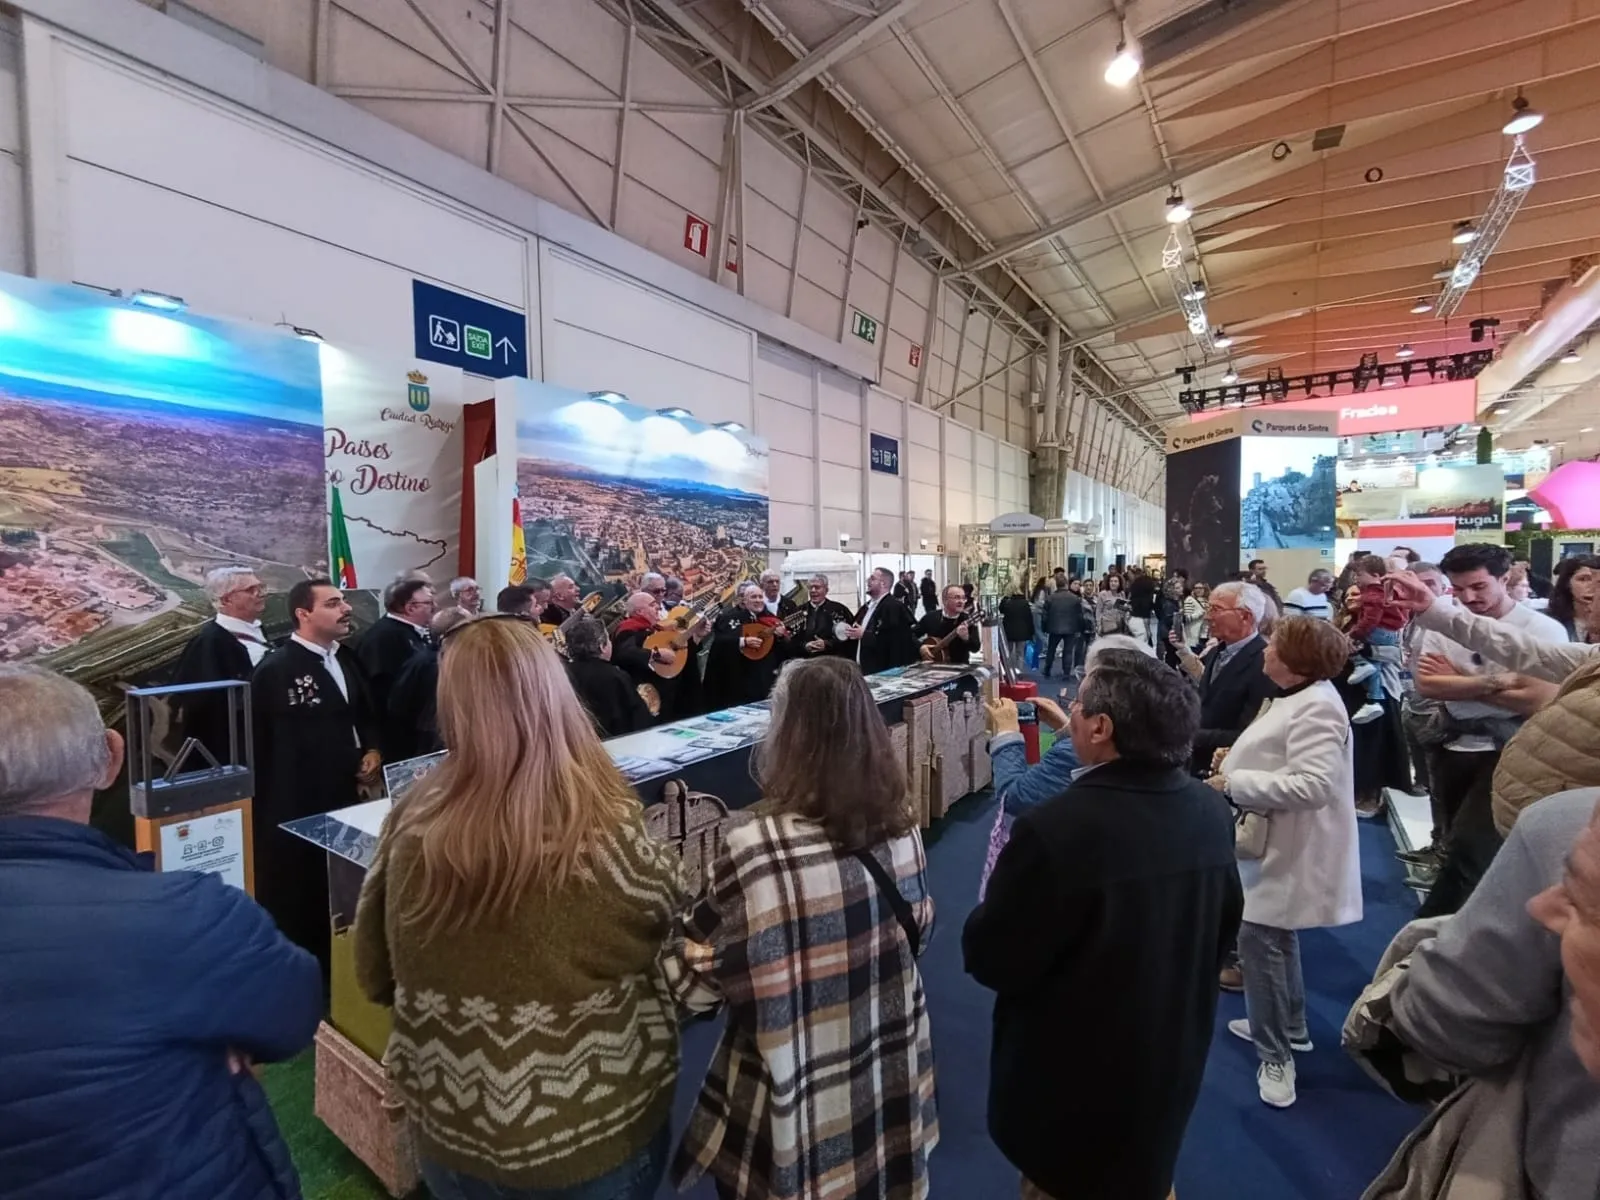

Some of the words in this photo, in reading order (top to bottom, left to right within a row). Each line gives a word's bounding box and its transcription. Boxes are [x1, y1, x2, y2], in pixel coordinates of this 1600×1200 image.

[471, 340, 486, 350] EXIT
[1266, 423, 1295, 432] Parques
[1308, 423, 1329, 432] Sintra
[1183, 433, 1206, 446] Parques
[1215, 426, 1234, 437] Sintra
[350, 464, 432, 495] Destino
